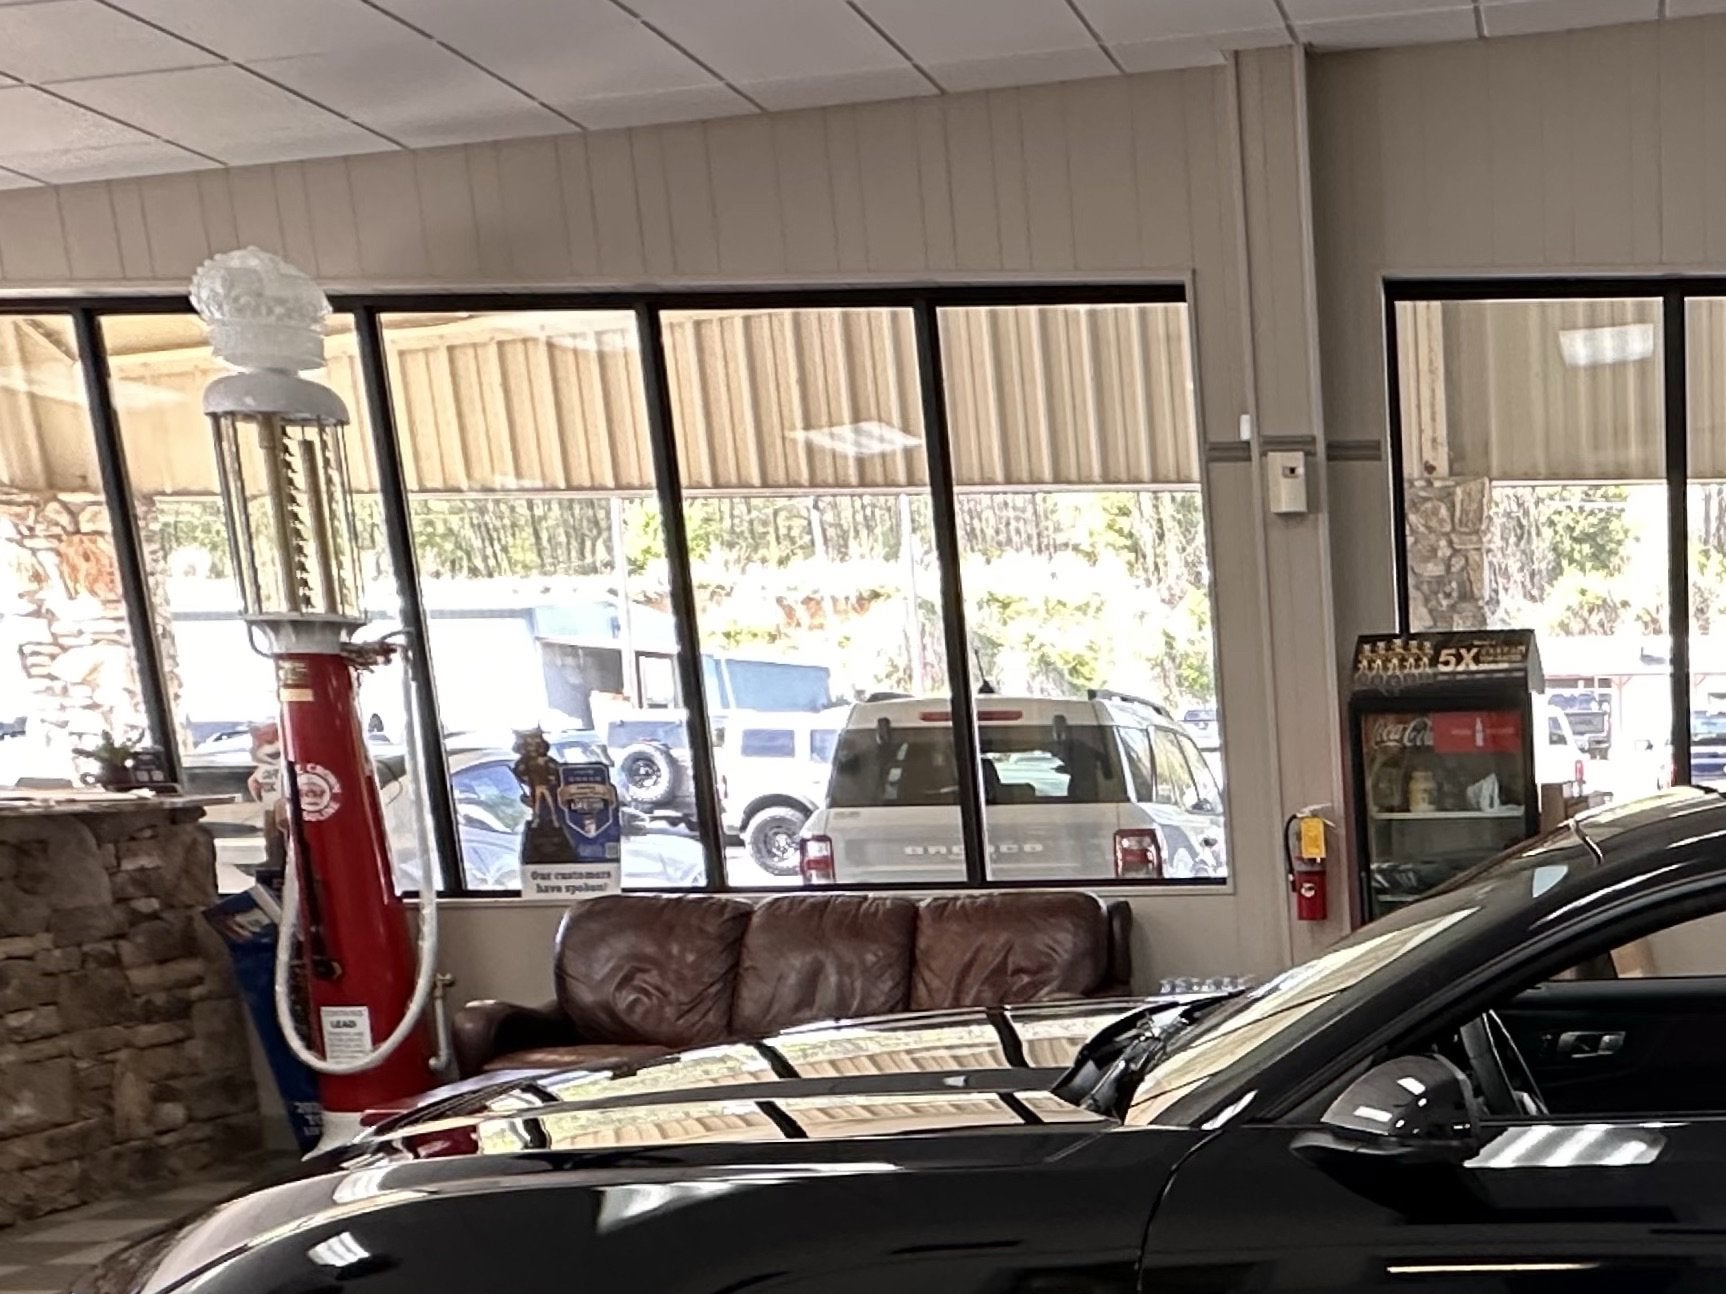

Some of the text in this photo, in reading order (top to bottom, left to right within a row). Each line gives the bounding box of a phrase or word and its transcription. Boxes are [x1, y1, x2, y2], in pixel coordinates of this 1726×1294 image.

[1437, 647, 1480, 672] 5X
[531, 870, 612, 881] Our customers
[536, 882, 608, 895] have spoken!
